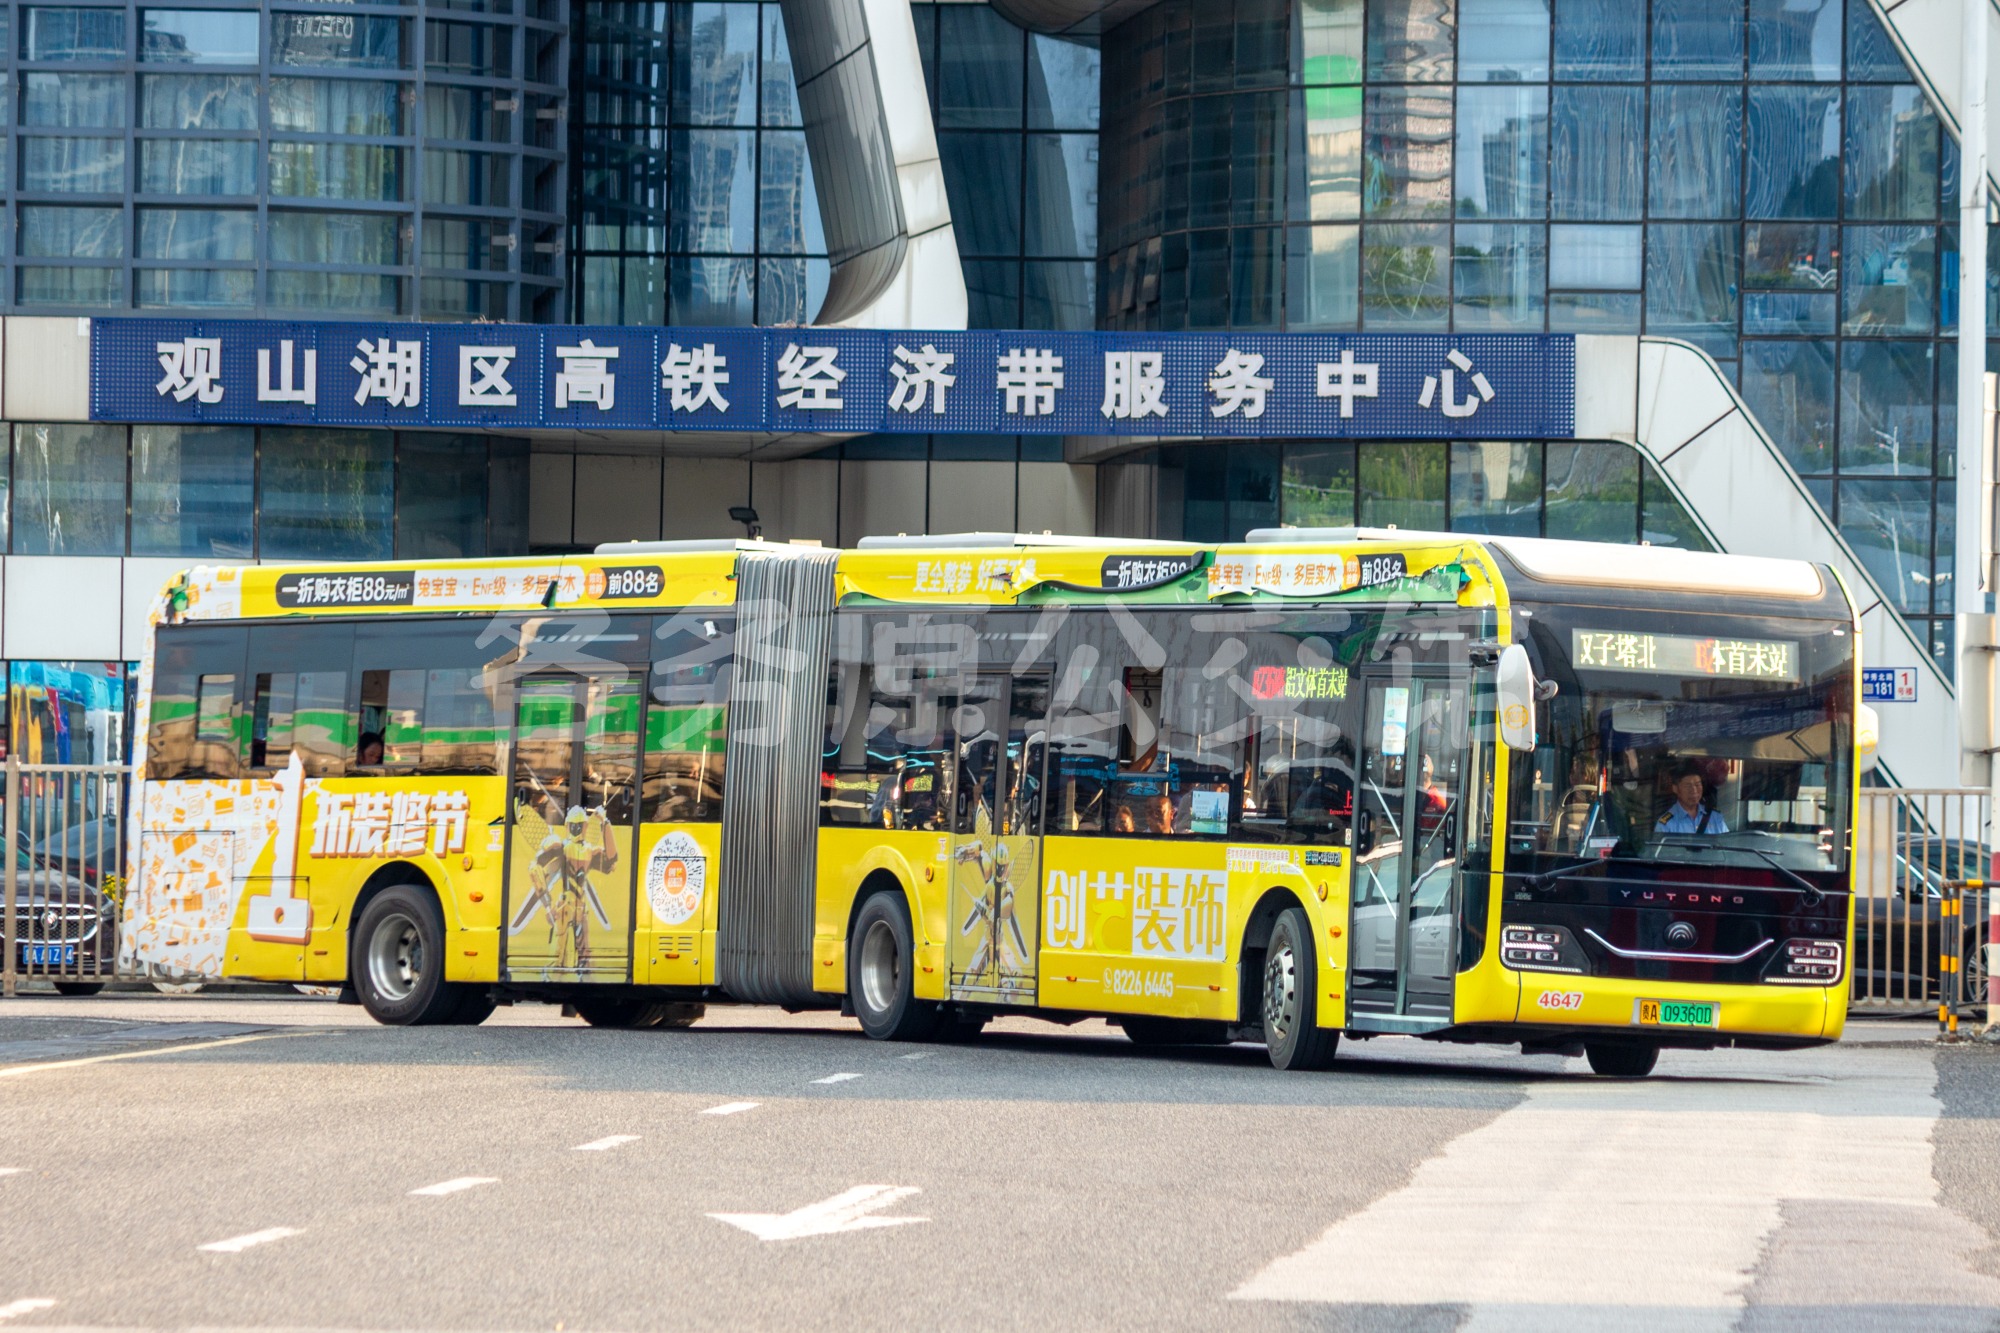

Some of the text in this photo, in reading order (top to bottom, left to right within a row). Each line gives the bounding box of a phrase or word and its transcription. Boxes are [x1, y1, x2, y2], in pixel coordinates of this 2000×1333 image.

[156, 337, 1496, 420] 观山湖区高铁经济带服务中心
[608, 569, 659, 595] 前88名
[1875, 682, 1893, 696] 181
[1620, 889, 1744, 904] YUTONG
[1045, 869, 1225, 957] 创艺装饰
[1113, 969, 1174, 998] 8226 6445
[1538, 992, 1583, 1009] 4647
